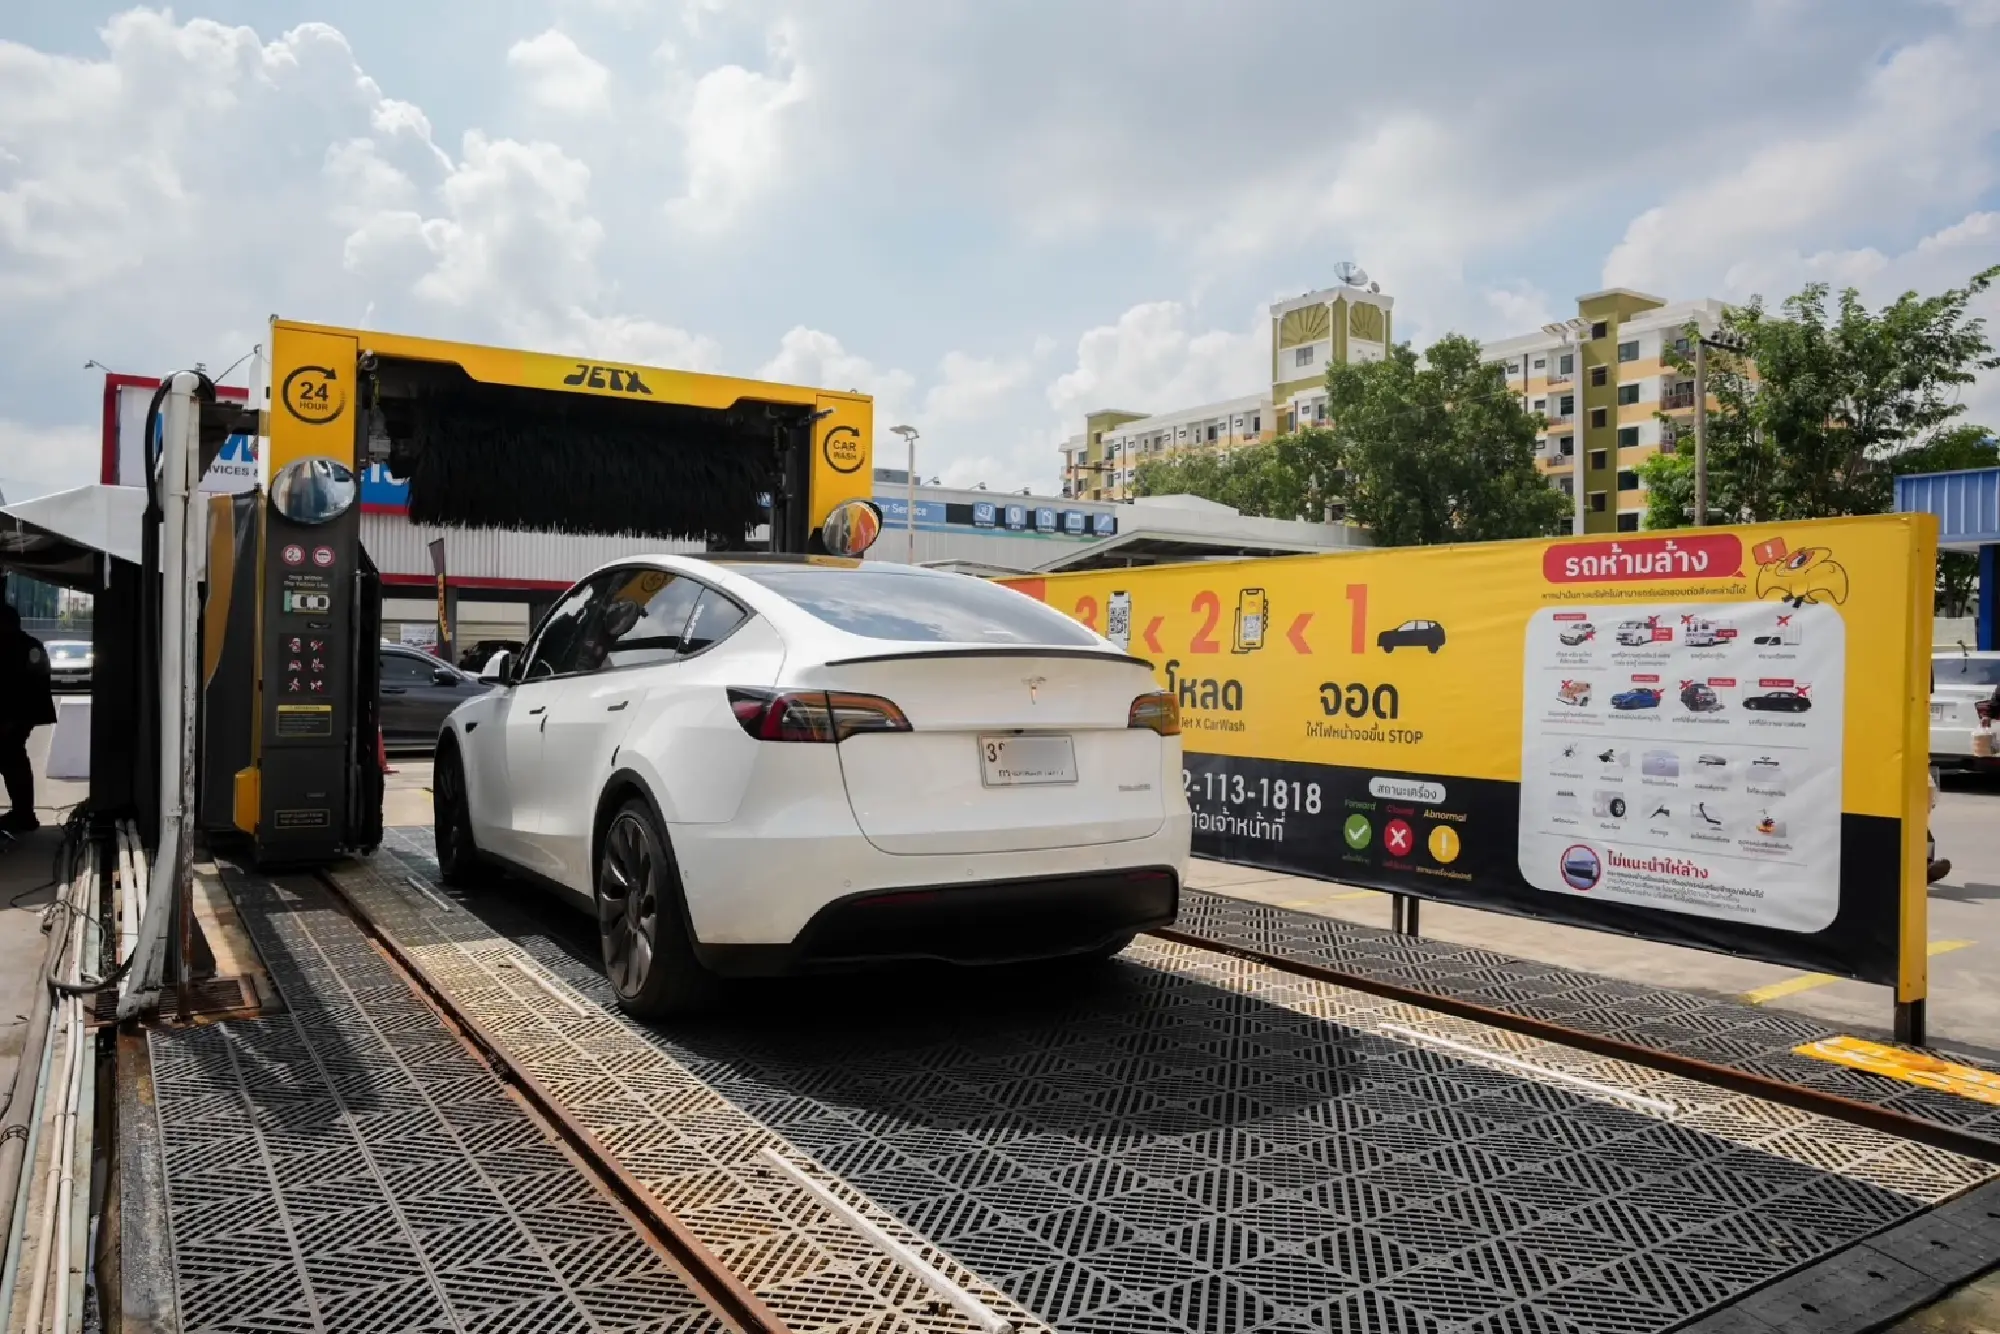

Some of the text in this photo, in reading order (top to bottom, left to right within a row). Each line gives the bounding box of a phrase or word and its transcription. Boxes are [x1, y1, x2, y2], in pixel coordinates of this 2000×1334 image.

[563, 364, 654, 396] JETX
[300, 381, 329, 402] 24
[299, 402, 329, 412] HOUR
[833, 439, 857, 452] CAR
[833, 451, 857, 461] WASH
[1564, 539, 1710, 577] รถห้ามล้าง
[1075, 583, 1369, 655] 3 2 1
[1319, 681, 1400, 720] จอด
[1195, 717, 1203, 729] X
[1203, 717, 1245, 733] CarWash
[1388, 729, 1424, 745] STOP
[1376, 783, 1438, 801] สถานะเครื่อง
[1423, 808, 1468, 823] Abnormal
[1606, 849, 1710, 879] ไม่แนะนำให้ล้าง
